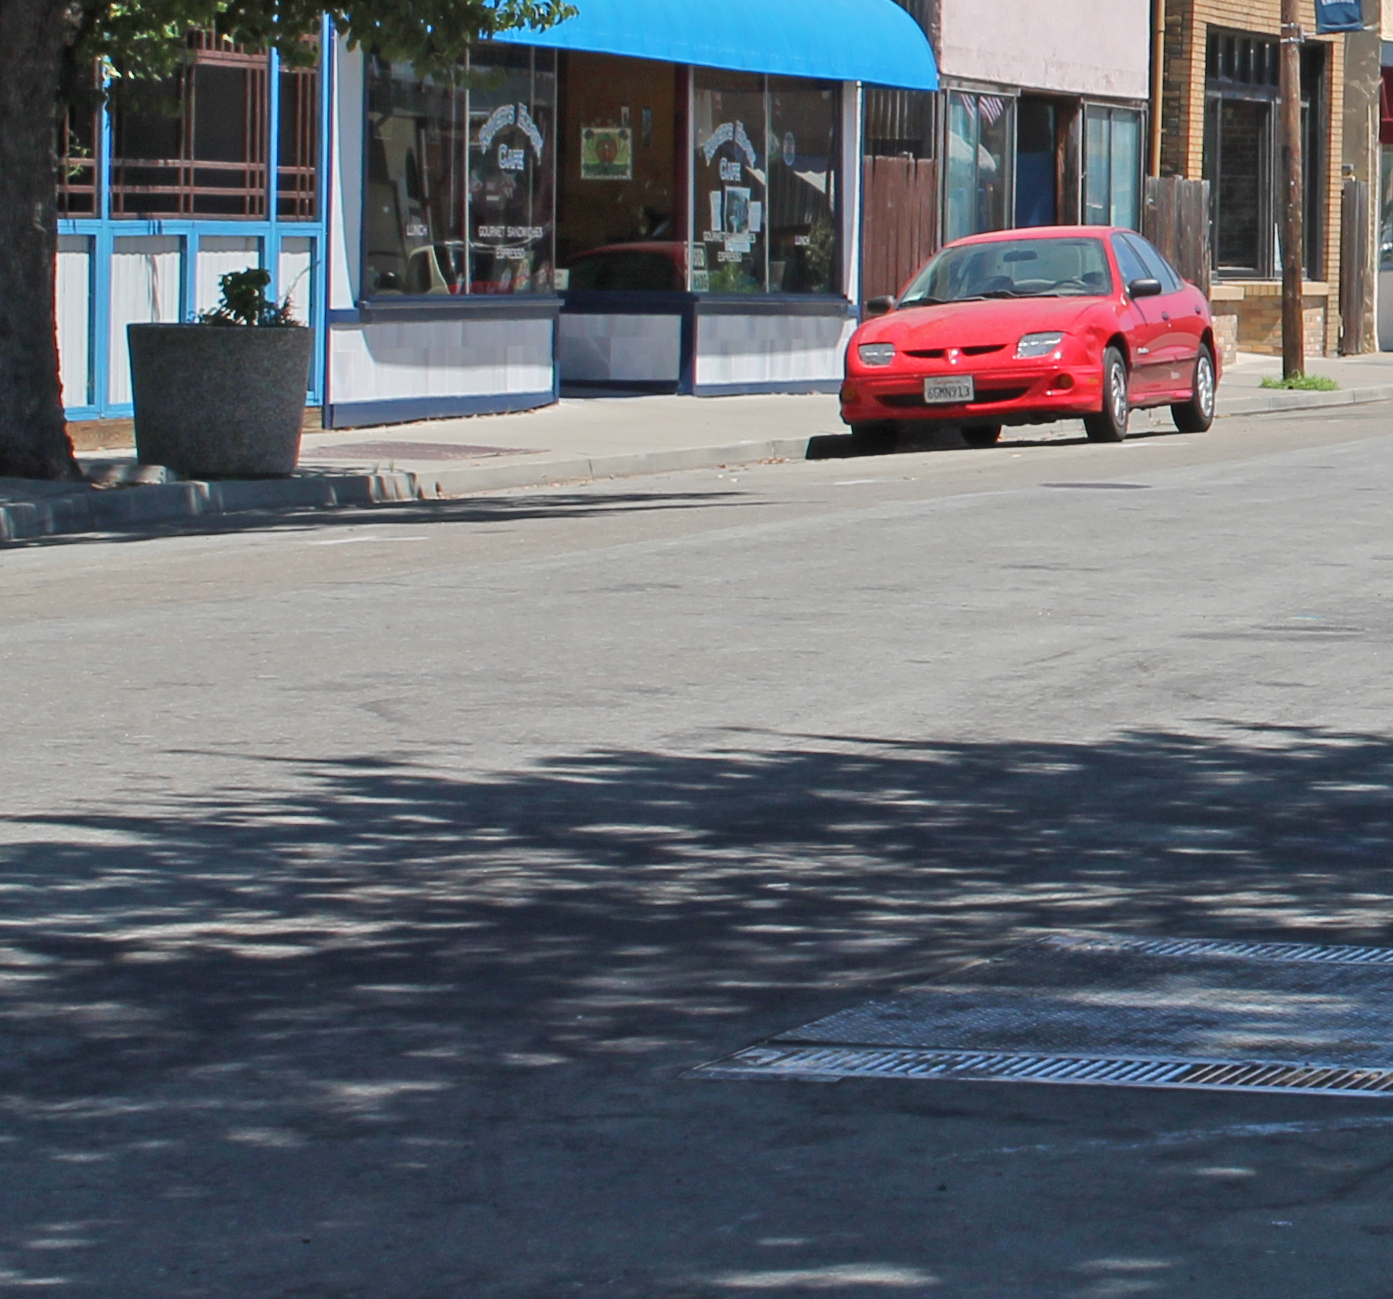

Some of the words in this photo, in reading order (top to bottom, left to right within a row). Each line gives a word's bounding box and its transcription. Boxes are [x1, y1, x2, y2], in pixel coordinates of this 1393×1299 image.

[406, 224, 428, 237] LUNCH
[478, 225, 505, 238] GOURMET
[506, 226, 543, 238] SANDWICHES
[495, 247, 526, 260] ESPRESSO
